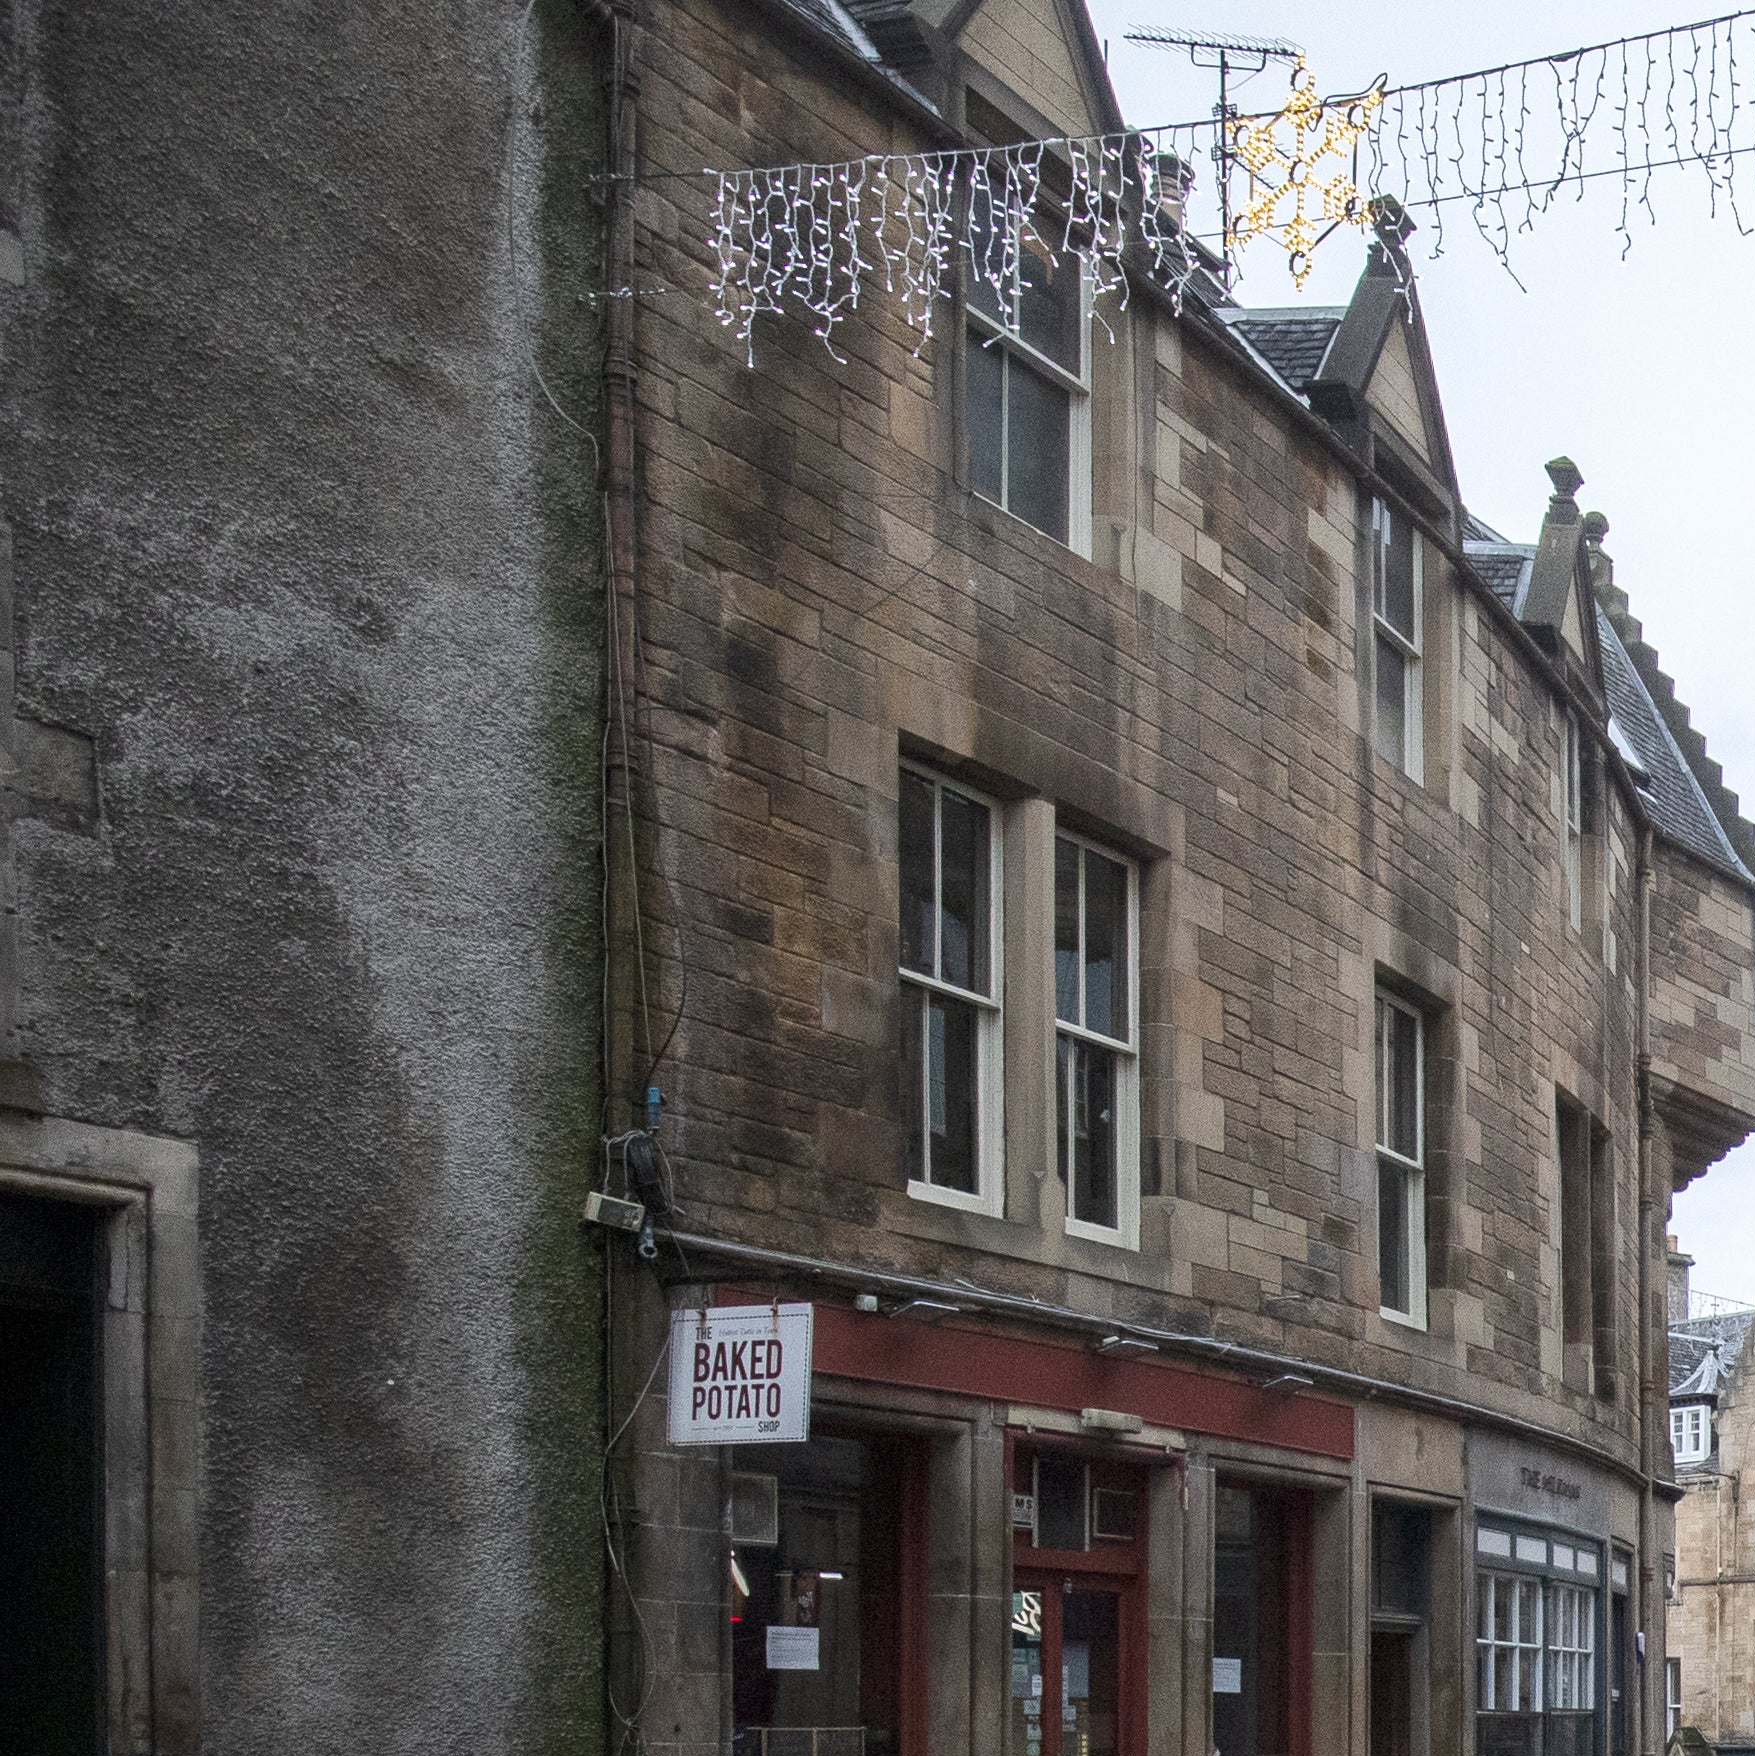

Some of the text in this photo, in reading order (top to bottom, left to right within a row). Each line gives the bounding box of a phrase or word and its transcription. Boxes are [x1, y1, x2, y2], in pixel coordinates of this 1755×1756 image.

[695, 1326, 713, 1341] THE
[693, 1339, 783, 1383] BAKED
[692, 1382, 782, 1421] POTATO
[758, 1420, 781, 1433] SHOP
